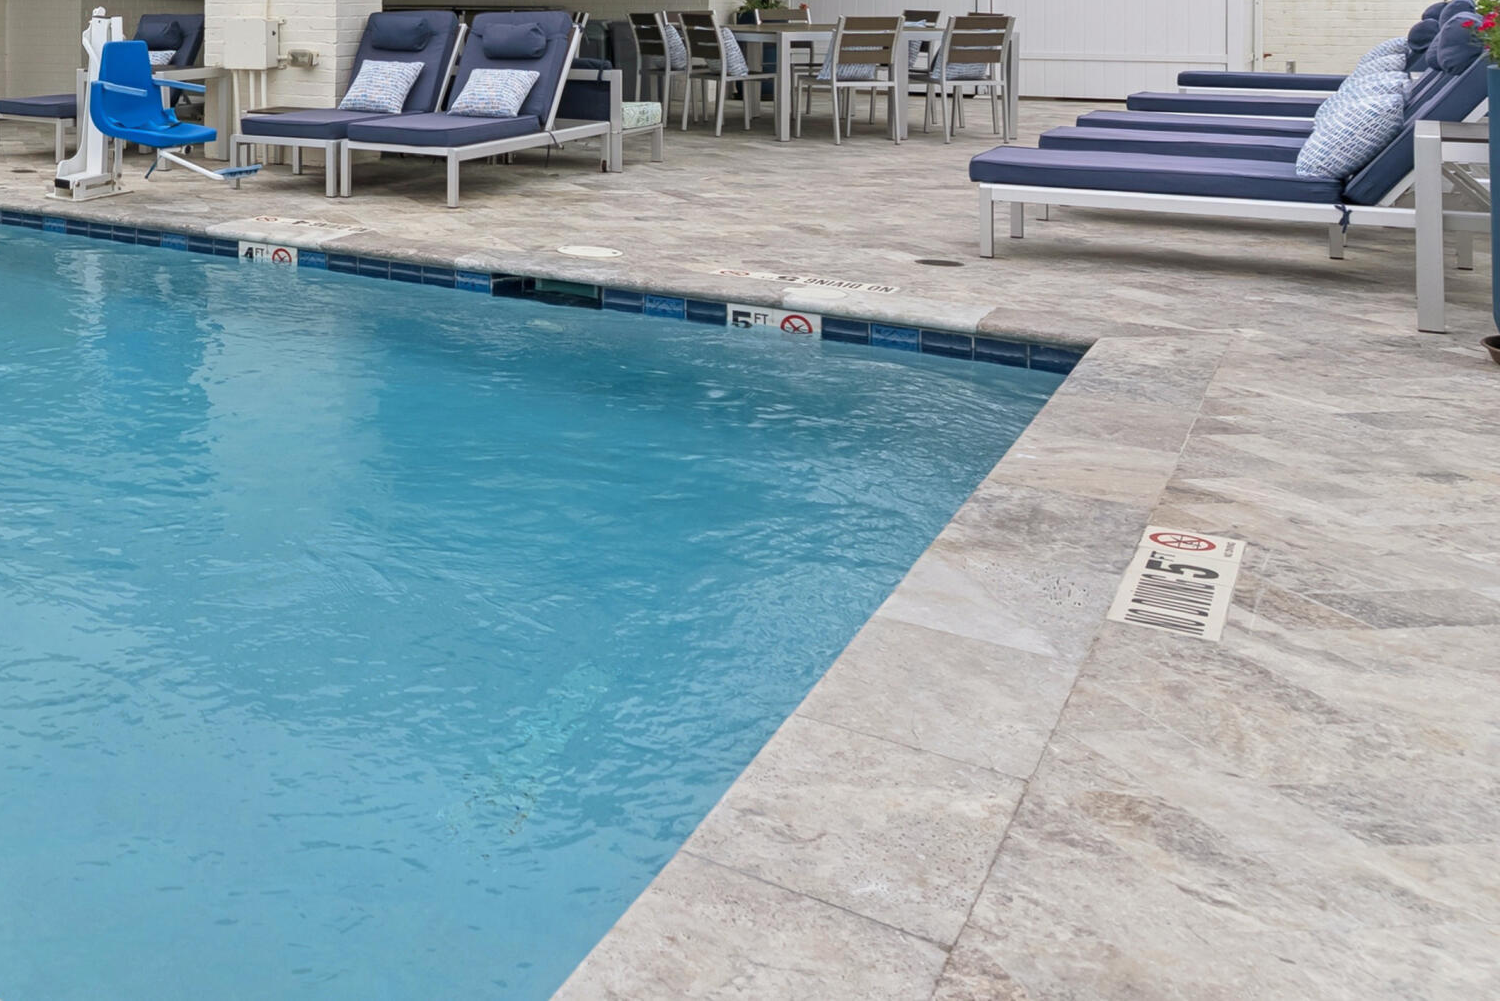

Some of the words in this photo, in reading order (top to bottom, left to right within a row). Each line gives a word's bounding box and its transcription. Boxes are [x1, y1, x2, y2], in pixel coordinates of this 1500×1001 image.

[243, 246, 254, 258] 4
[255, 247, 264, 256] FT
[803, 278, 863, 289] DIVING
[866, 285, 895, 294] NO
[731, 310, 753, 329] 5
[754, 313, 769, 325] FT
[1145, 559, 1220, 580] 5
[1131, 573, 1216, 618] DIVING
[1123, 608, 1207, 637] NO
